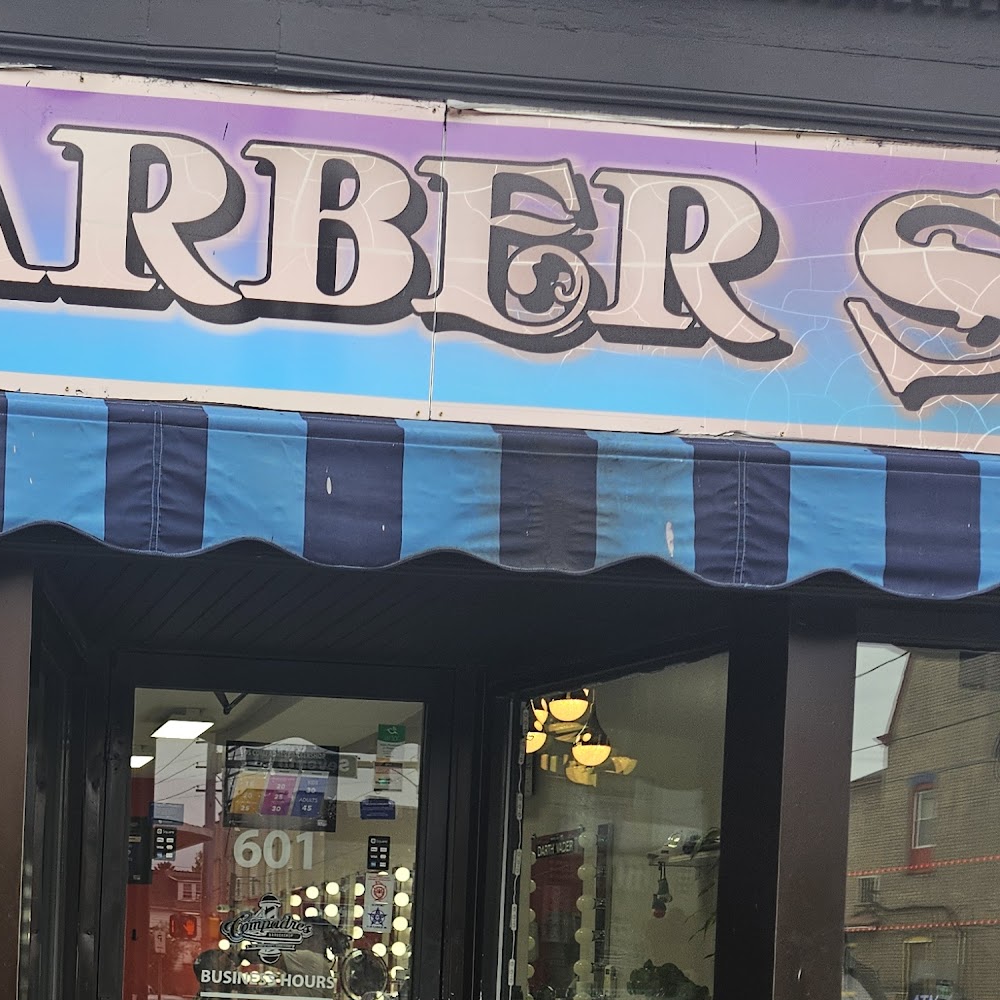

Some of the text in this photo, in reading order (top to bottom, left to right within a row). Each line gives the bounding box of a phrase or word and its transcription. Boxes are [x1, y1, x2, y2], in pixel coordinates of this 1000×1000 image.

[301, 804, 312, 812] 45
[233, 829, 315, 870] 601
[537, 843, 555, 857] DARTH
[222, 912, 313, 942] Compadres
[201, 969, 335, 990] BUSINESS HOURS
